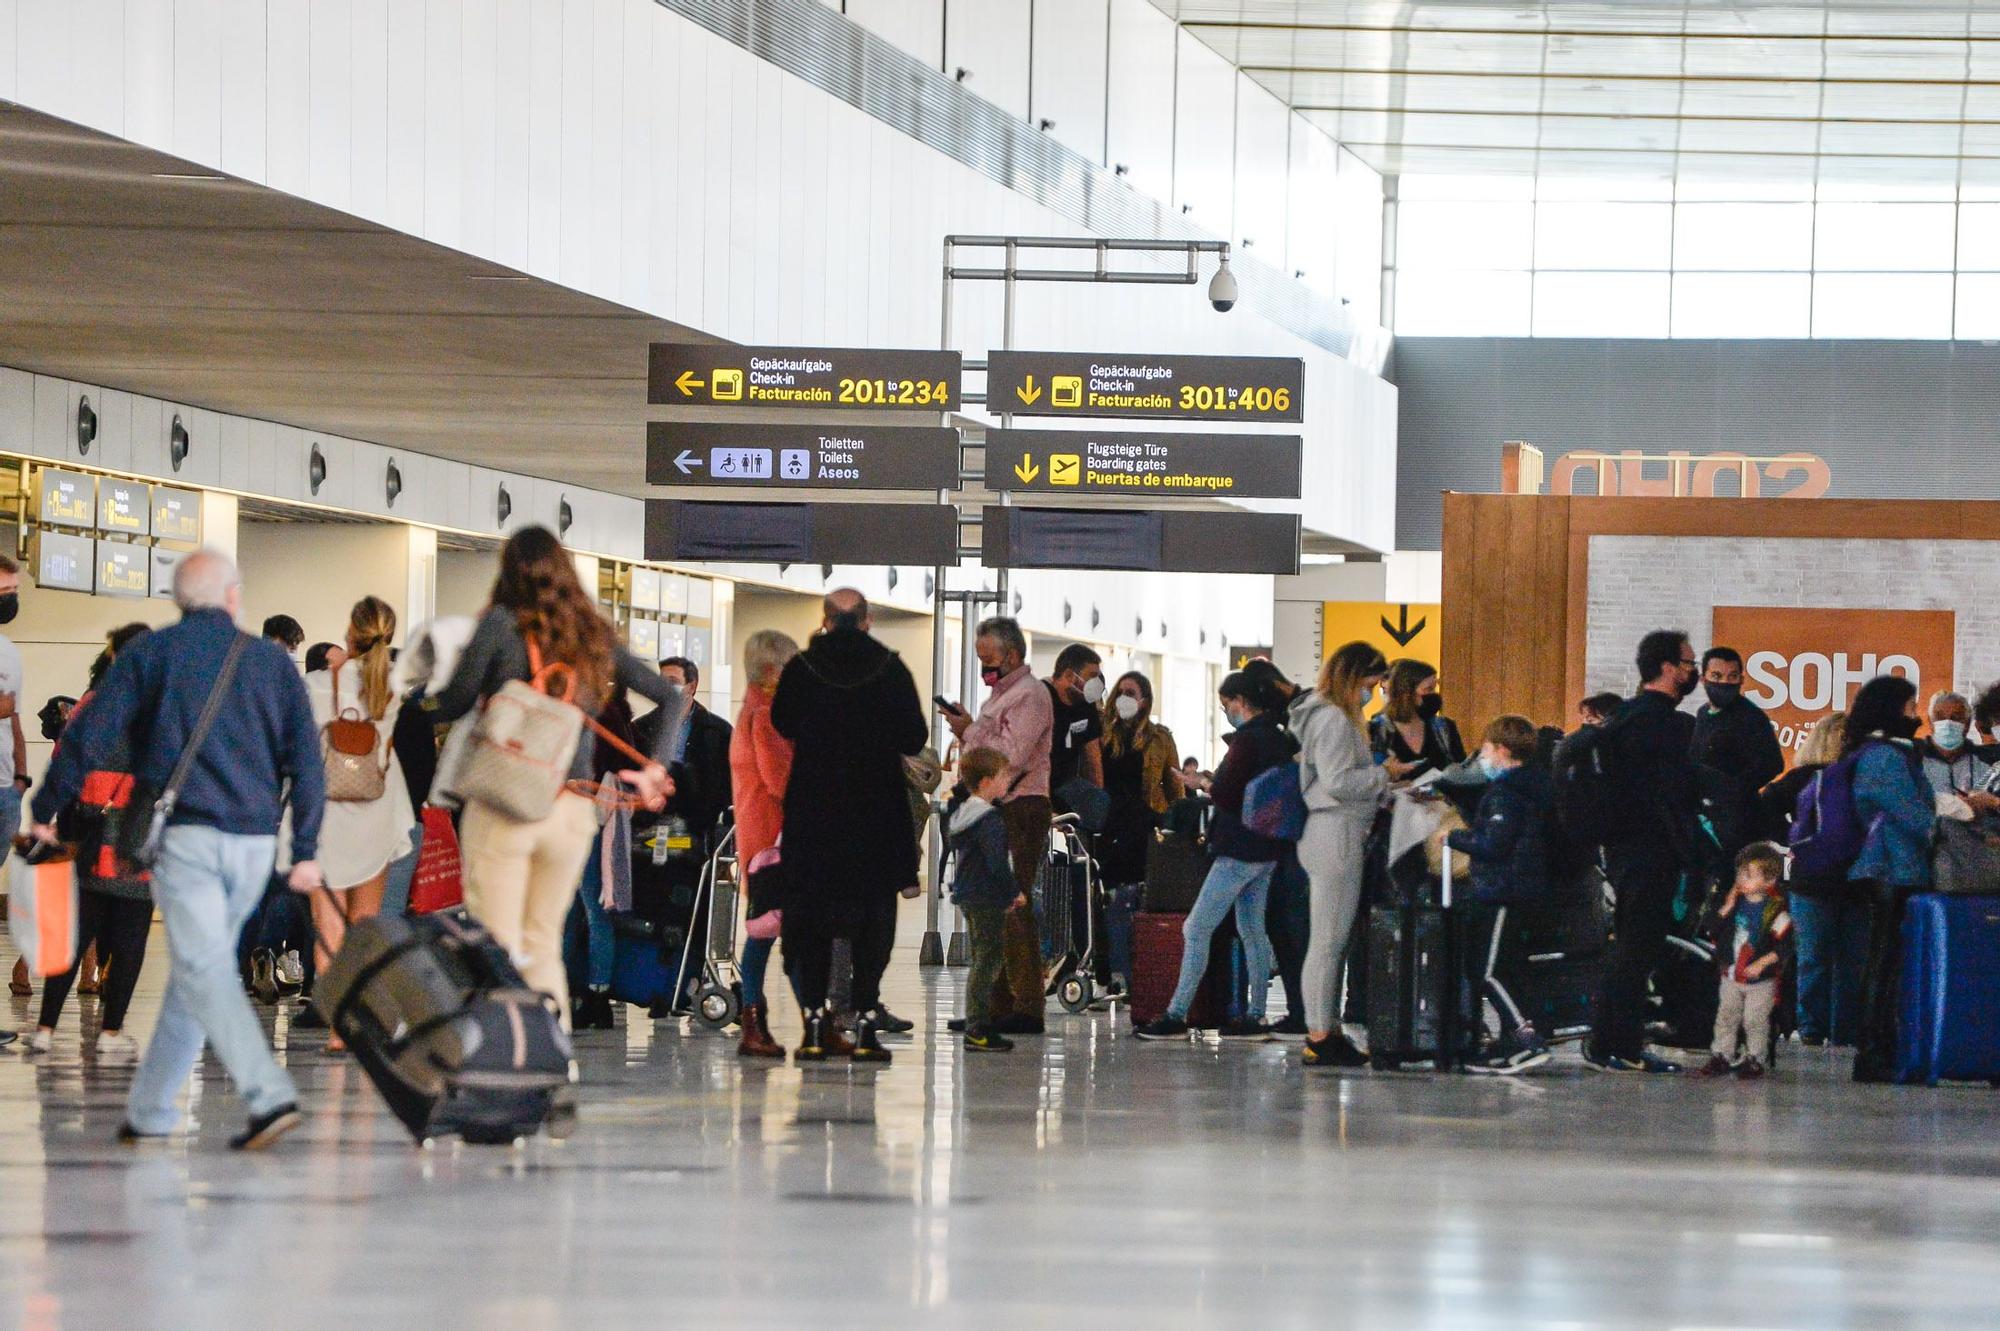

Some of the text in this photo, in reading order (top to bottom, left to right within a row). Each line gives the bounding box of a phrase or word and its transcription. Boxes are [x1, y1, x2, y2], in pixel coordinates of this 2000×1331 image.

[750, 357, 833, 373] Gepäckaufgabe
[1090, 364, 1173, 379] Gepäckaufgabe
[750, 372, 795, 385] Check-in
[888, 380, 898, 391] to
[1089, 378, 1134, 391] Check-in
[749, 378, 948, 404] Facturación 201 a 234
[1089, 385, 1290, 411] Facturación 301 a 406
[1228, 387, 1238, 397] to
[818, 437, 864, 449] Toiletten
[1087, 442, 1168, 457] Flugsteige Türe
[818, 451, 853, 463] Toilets
[1087, 457, 1167, 472] Boarding gates
[818, 466, 859, 479] Aseos
[1086, 471, 1233, 490] Puertas de embarque
